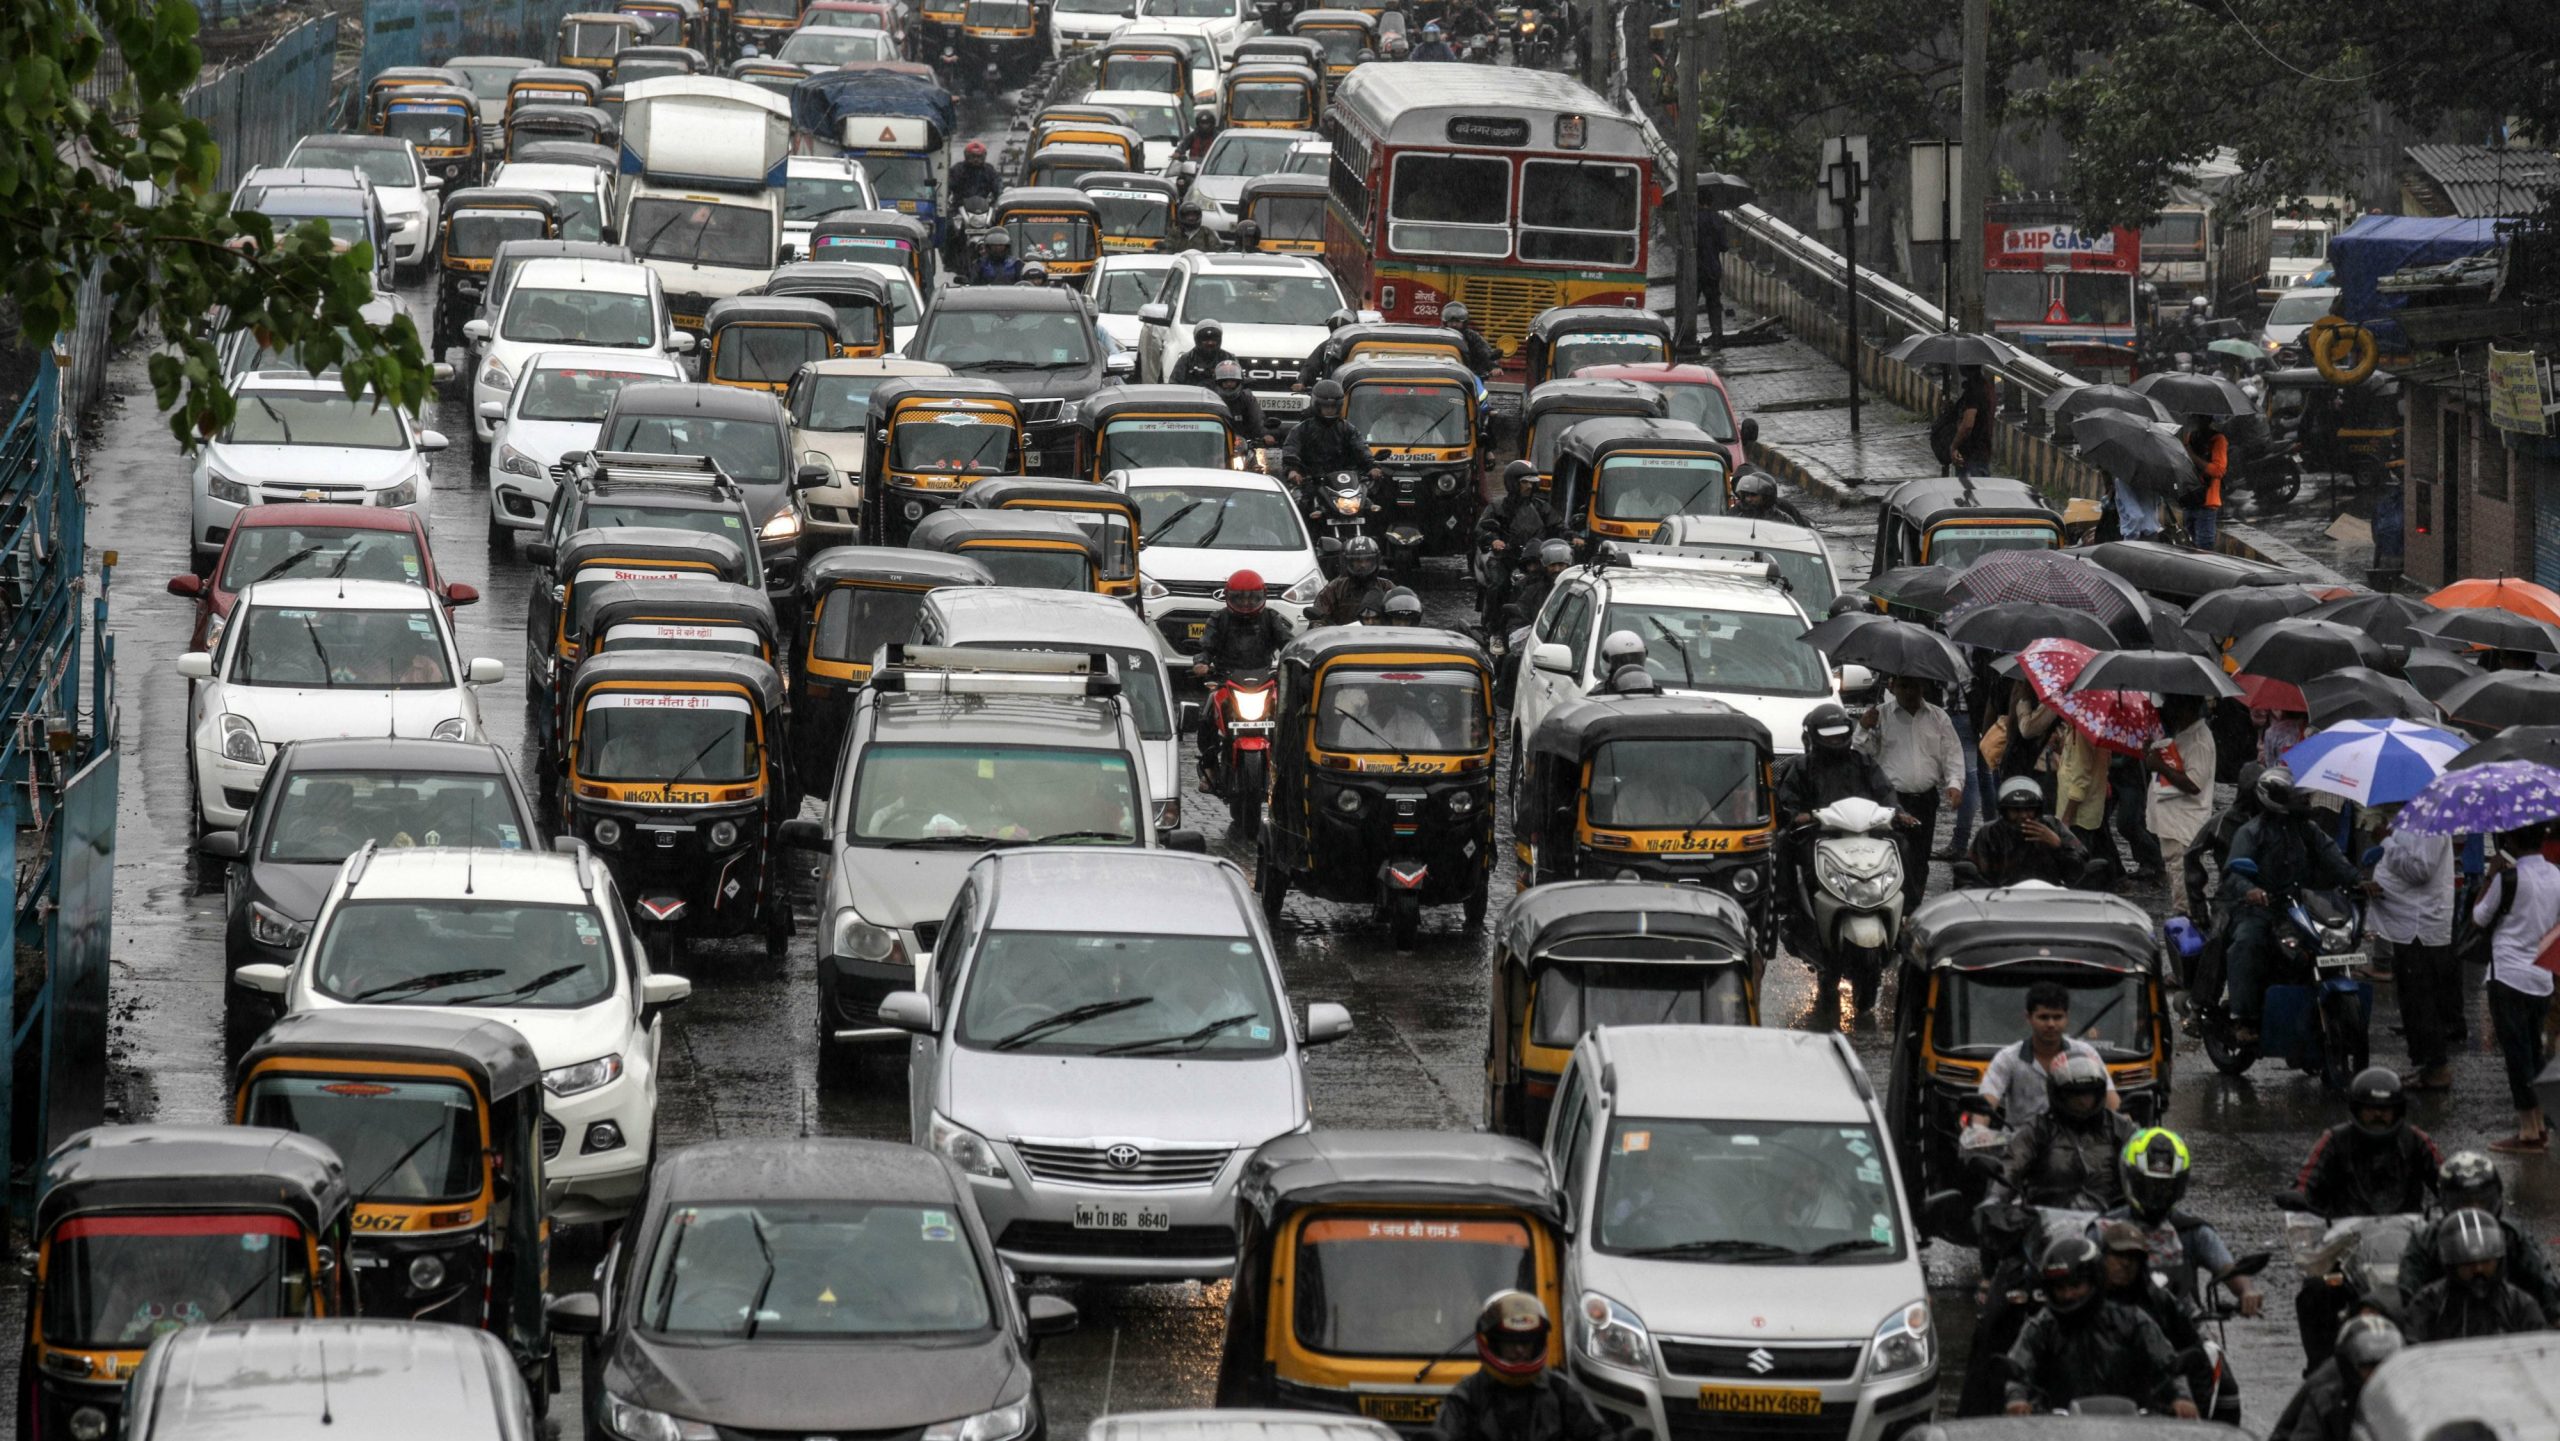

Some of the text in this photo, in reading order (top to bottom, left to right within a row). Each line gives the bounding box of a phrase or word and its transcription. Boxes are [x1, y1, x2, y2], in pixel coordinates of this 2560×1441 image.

[2023, 231, 2092, 250] HP GAS
[633, 698, 655, 707] जय
[687, 698, 699, 708] दी
[351, 1214, 410, 1231] 967
[1076, 1212, 1167, 1228] MH 01 BG 8640
[1383, 1220, 1447, 1237] जय श्री राम
[1701, 1391, 1820, 1413] MH04HY4687
